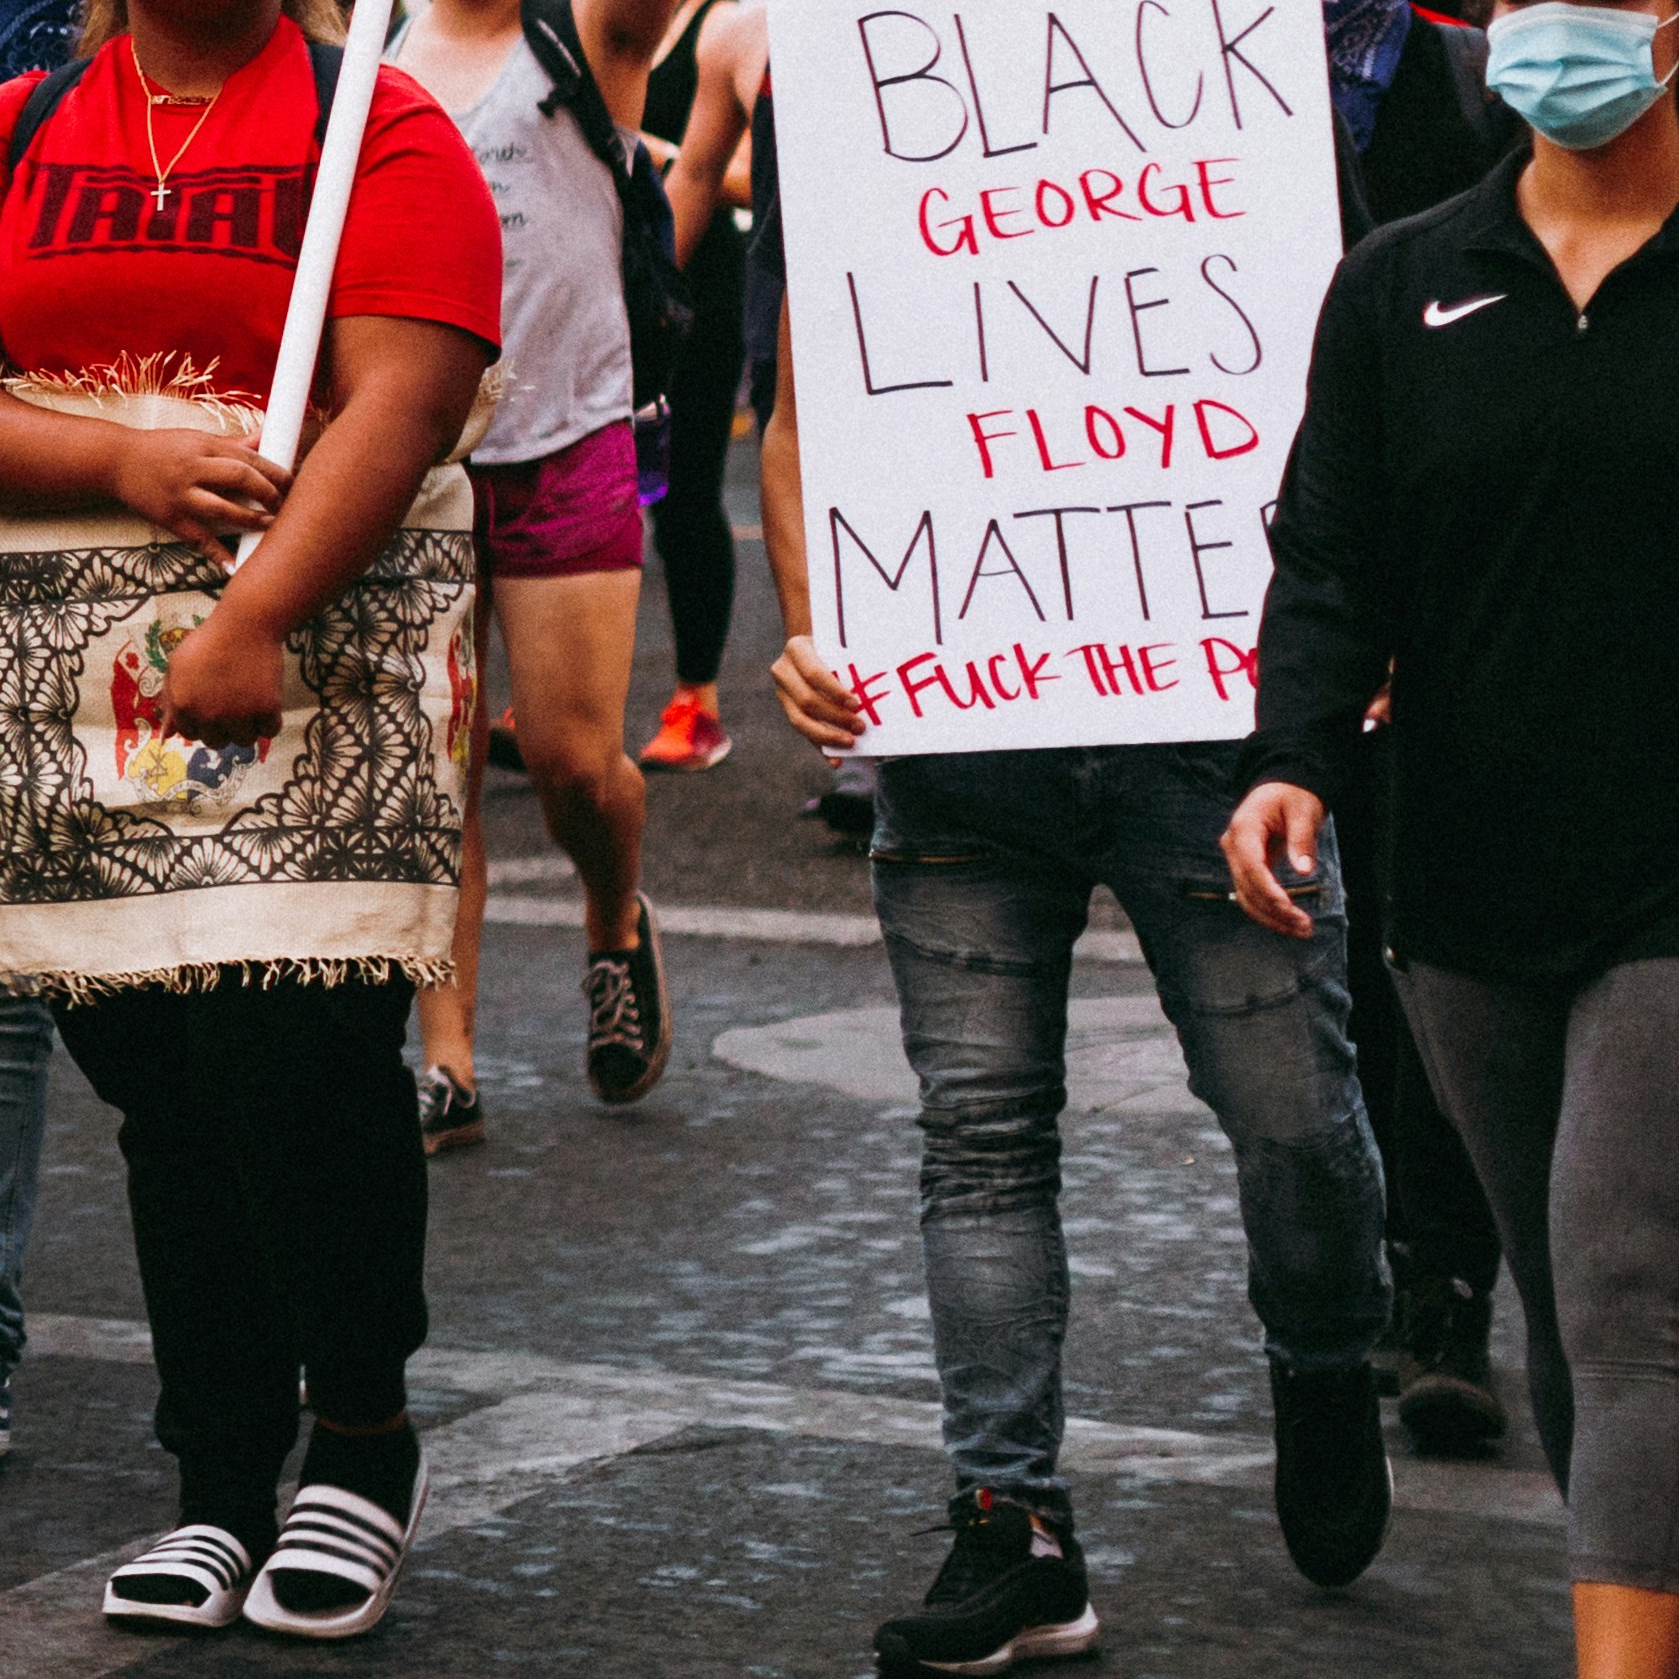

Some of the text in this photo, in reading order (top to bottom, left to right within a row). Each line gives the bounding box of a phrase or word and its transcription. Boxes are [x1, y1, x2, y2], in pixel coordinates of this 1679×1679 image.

[918, 158, 1247, 257] GEORGE
[848, 252, 1263, 396] LIVES
[967, 398, 1261, 478] FLOYD
[833, 643, 1062, 726] #FUCK
[1064, 643, 1181, 696] THE
